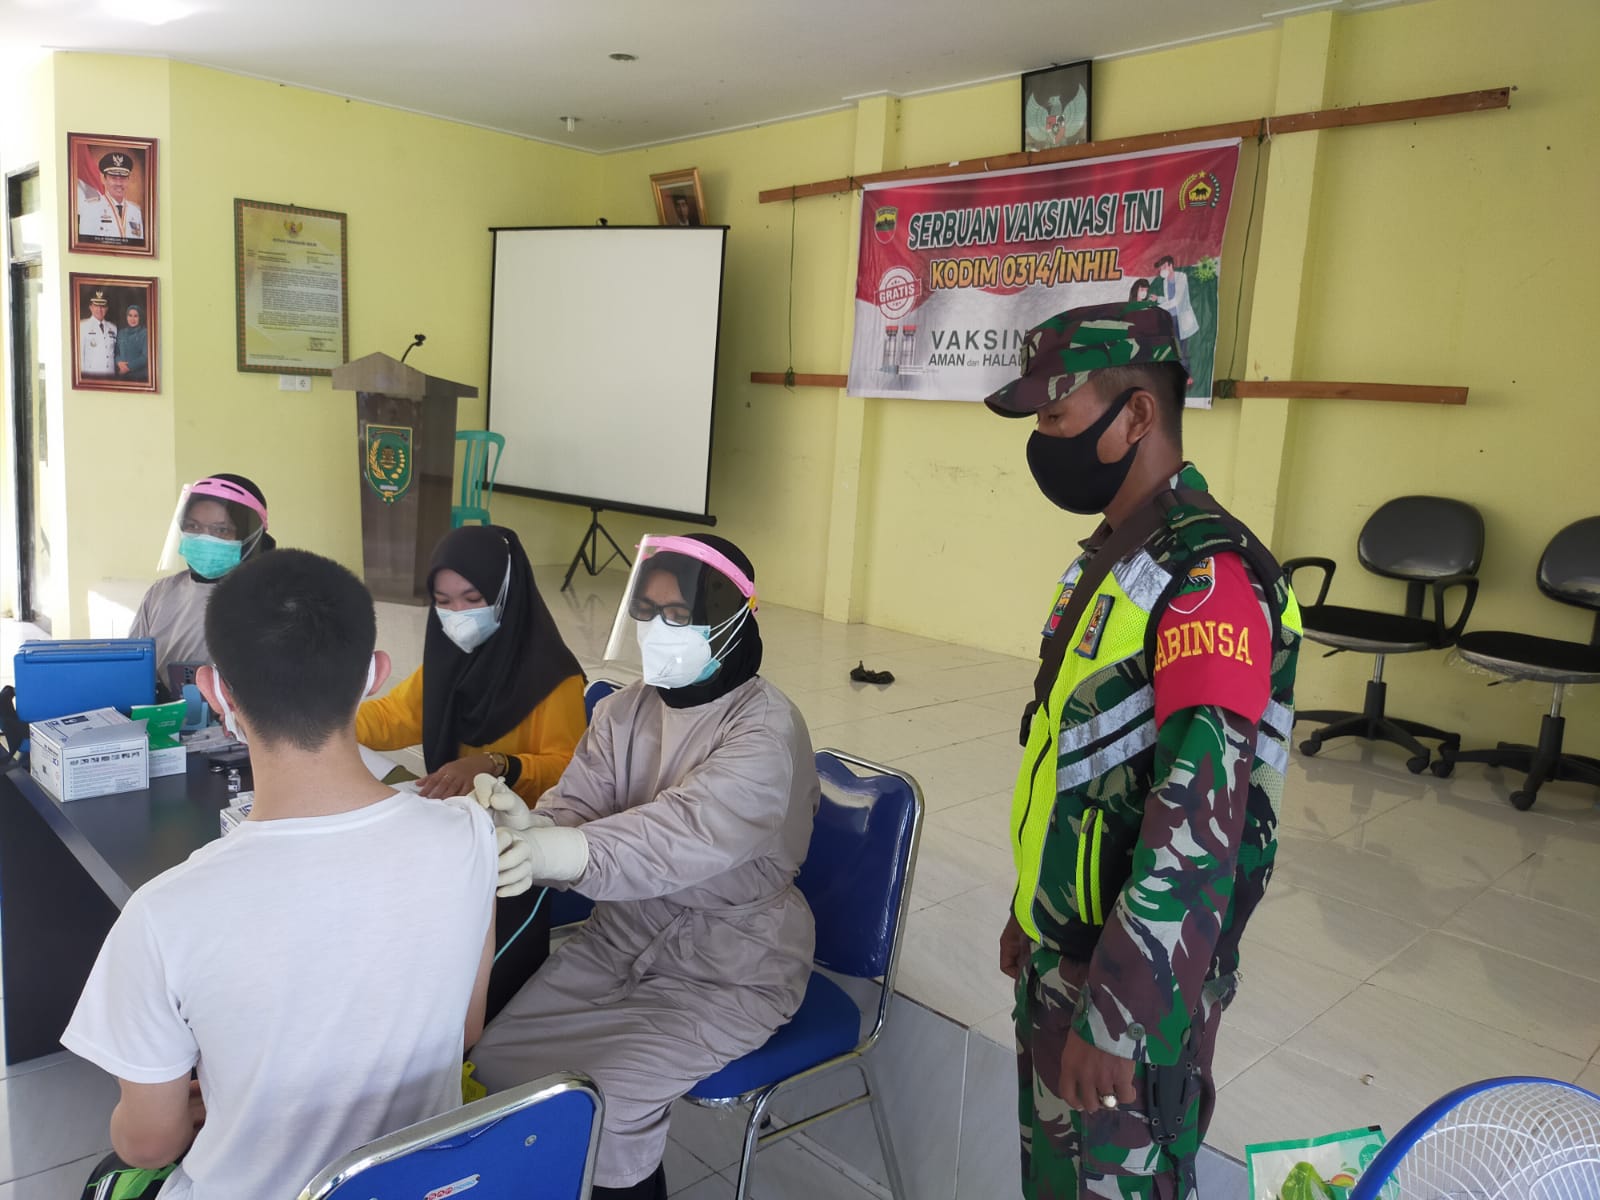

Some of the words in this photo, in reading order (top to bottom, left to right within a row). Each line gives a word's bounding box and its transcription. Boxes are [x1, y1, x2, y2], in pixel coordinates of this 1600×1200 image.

[908, 206, 1000, 249] SERBUAN
[1003, 193, 1119, 242] VAKSINASI
[1122, 188, 1163, 233] TNI
[931, 256, 999, 291] KODIM
[1001, 247, 1122, 287] 0314/INHIL
[880, 284, 915, 303] GRATIS
[931, 329, 1028, 350] VAKSIN
[928, 353, 965, 367] AMAN
[1153, 620, 1253, 673] ABINSA
